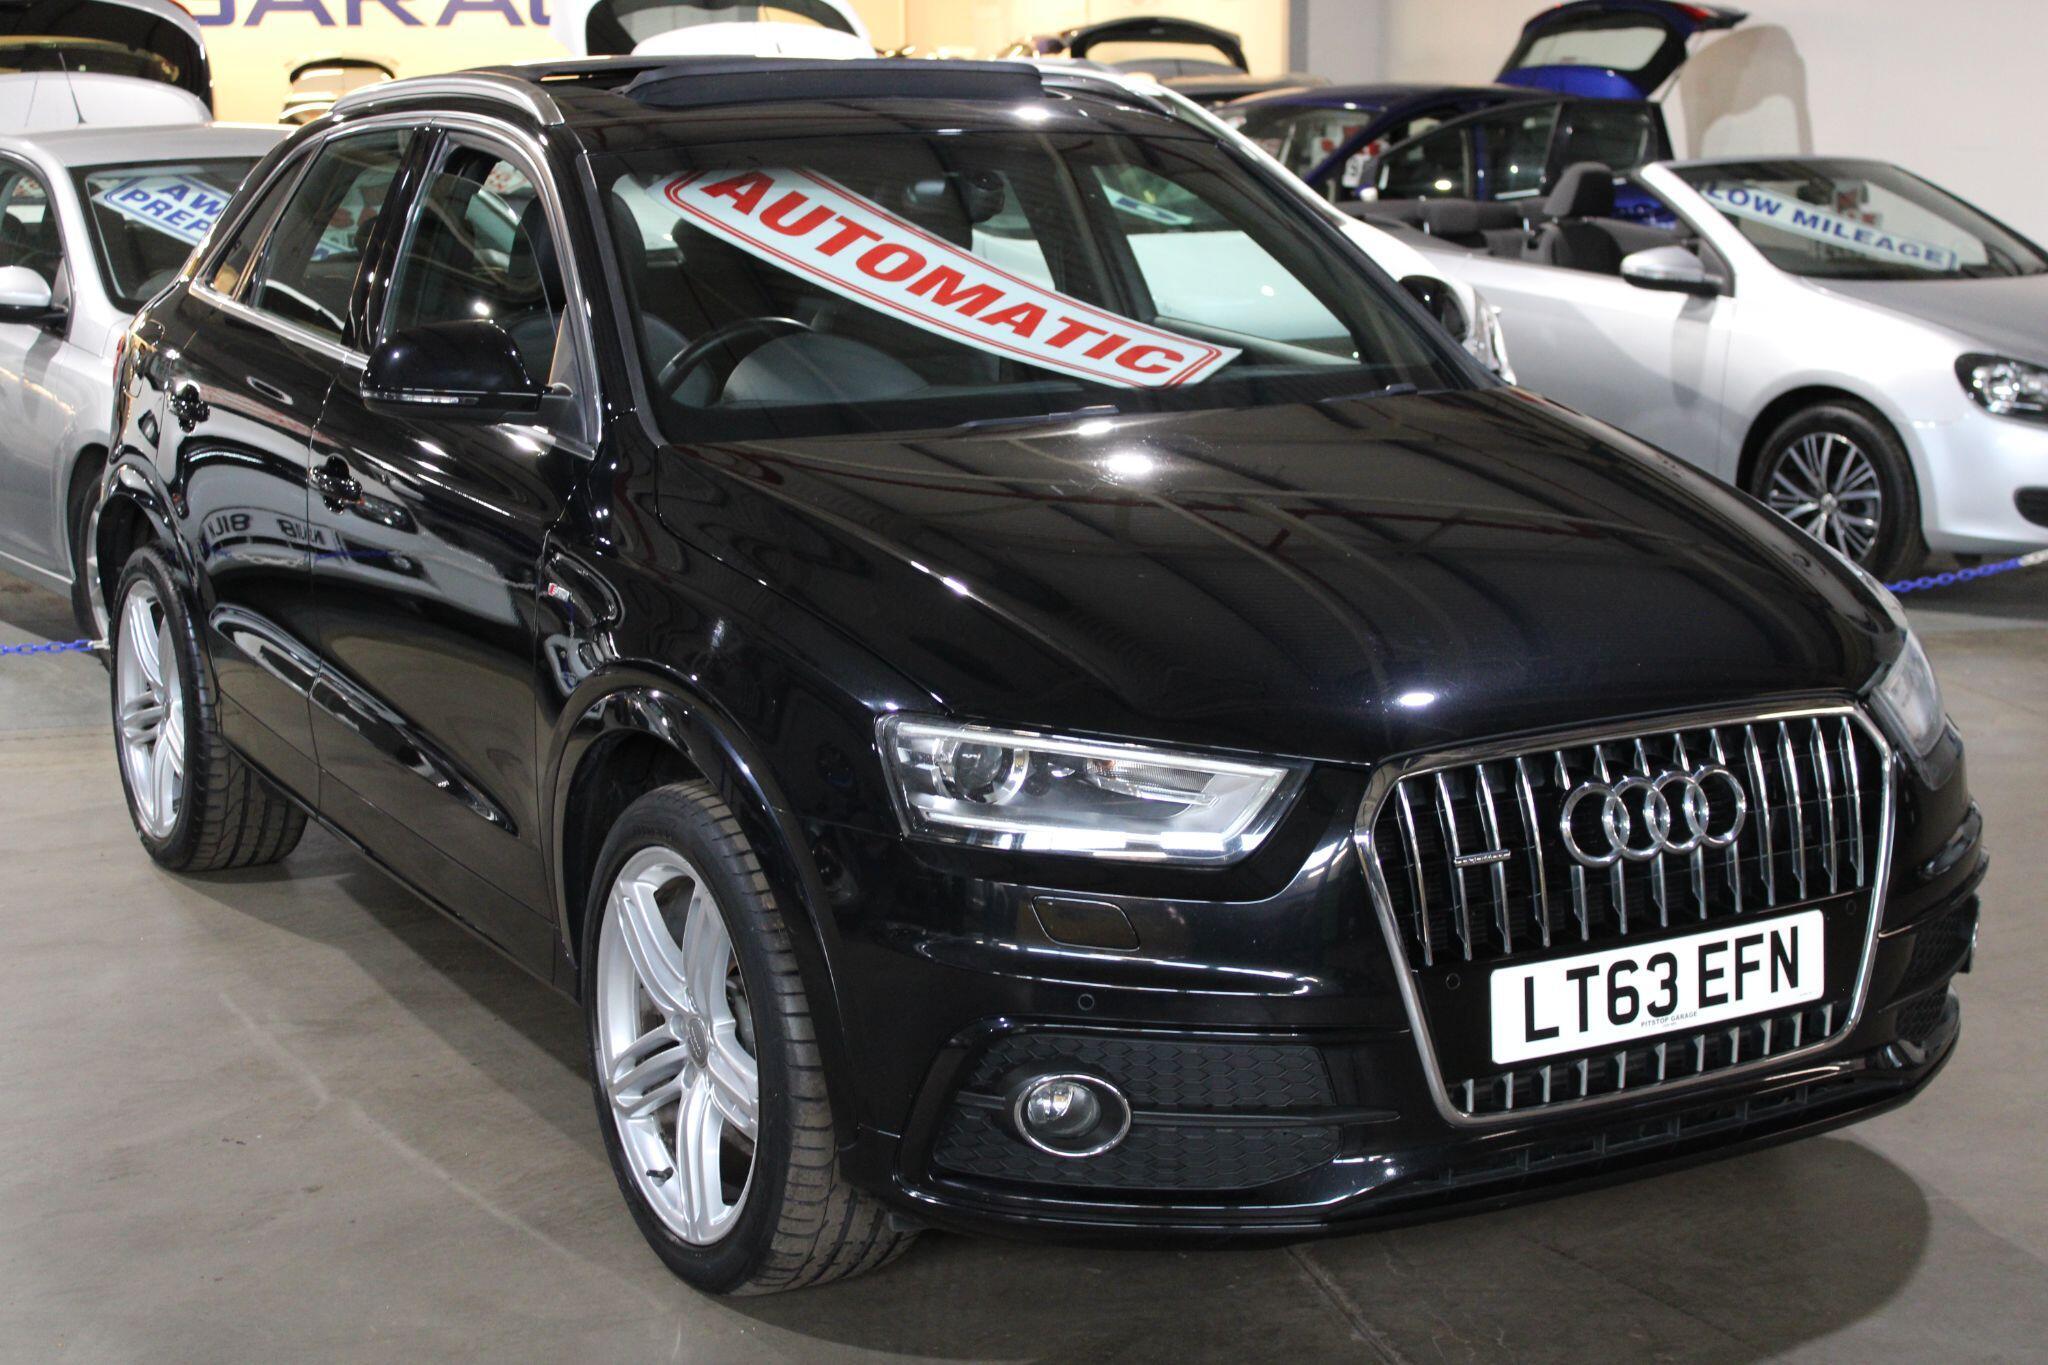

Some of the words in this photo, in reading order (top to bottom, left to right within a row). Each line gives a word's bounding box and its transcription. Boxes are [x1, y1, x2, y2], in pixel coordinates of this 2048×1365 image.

[702, 171, 1184, 374] AUTOMATIC
[1706, 181, 1783, 216] LOW
[1792, 210, 1945, 264] MILEAGE
[1524, 951, 1678, 1043] LT63
[1697, 925, 1800, 1009] EFN
[1641, 1017, 1669, 1027] PITSTOP
[1671, 1011, 1697, 1021] GARAGE
